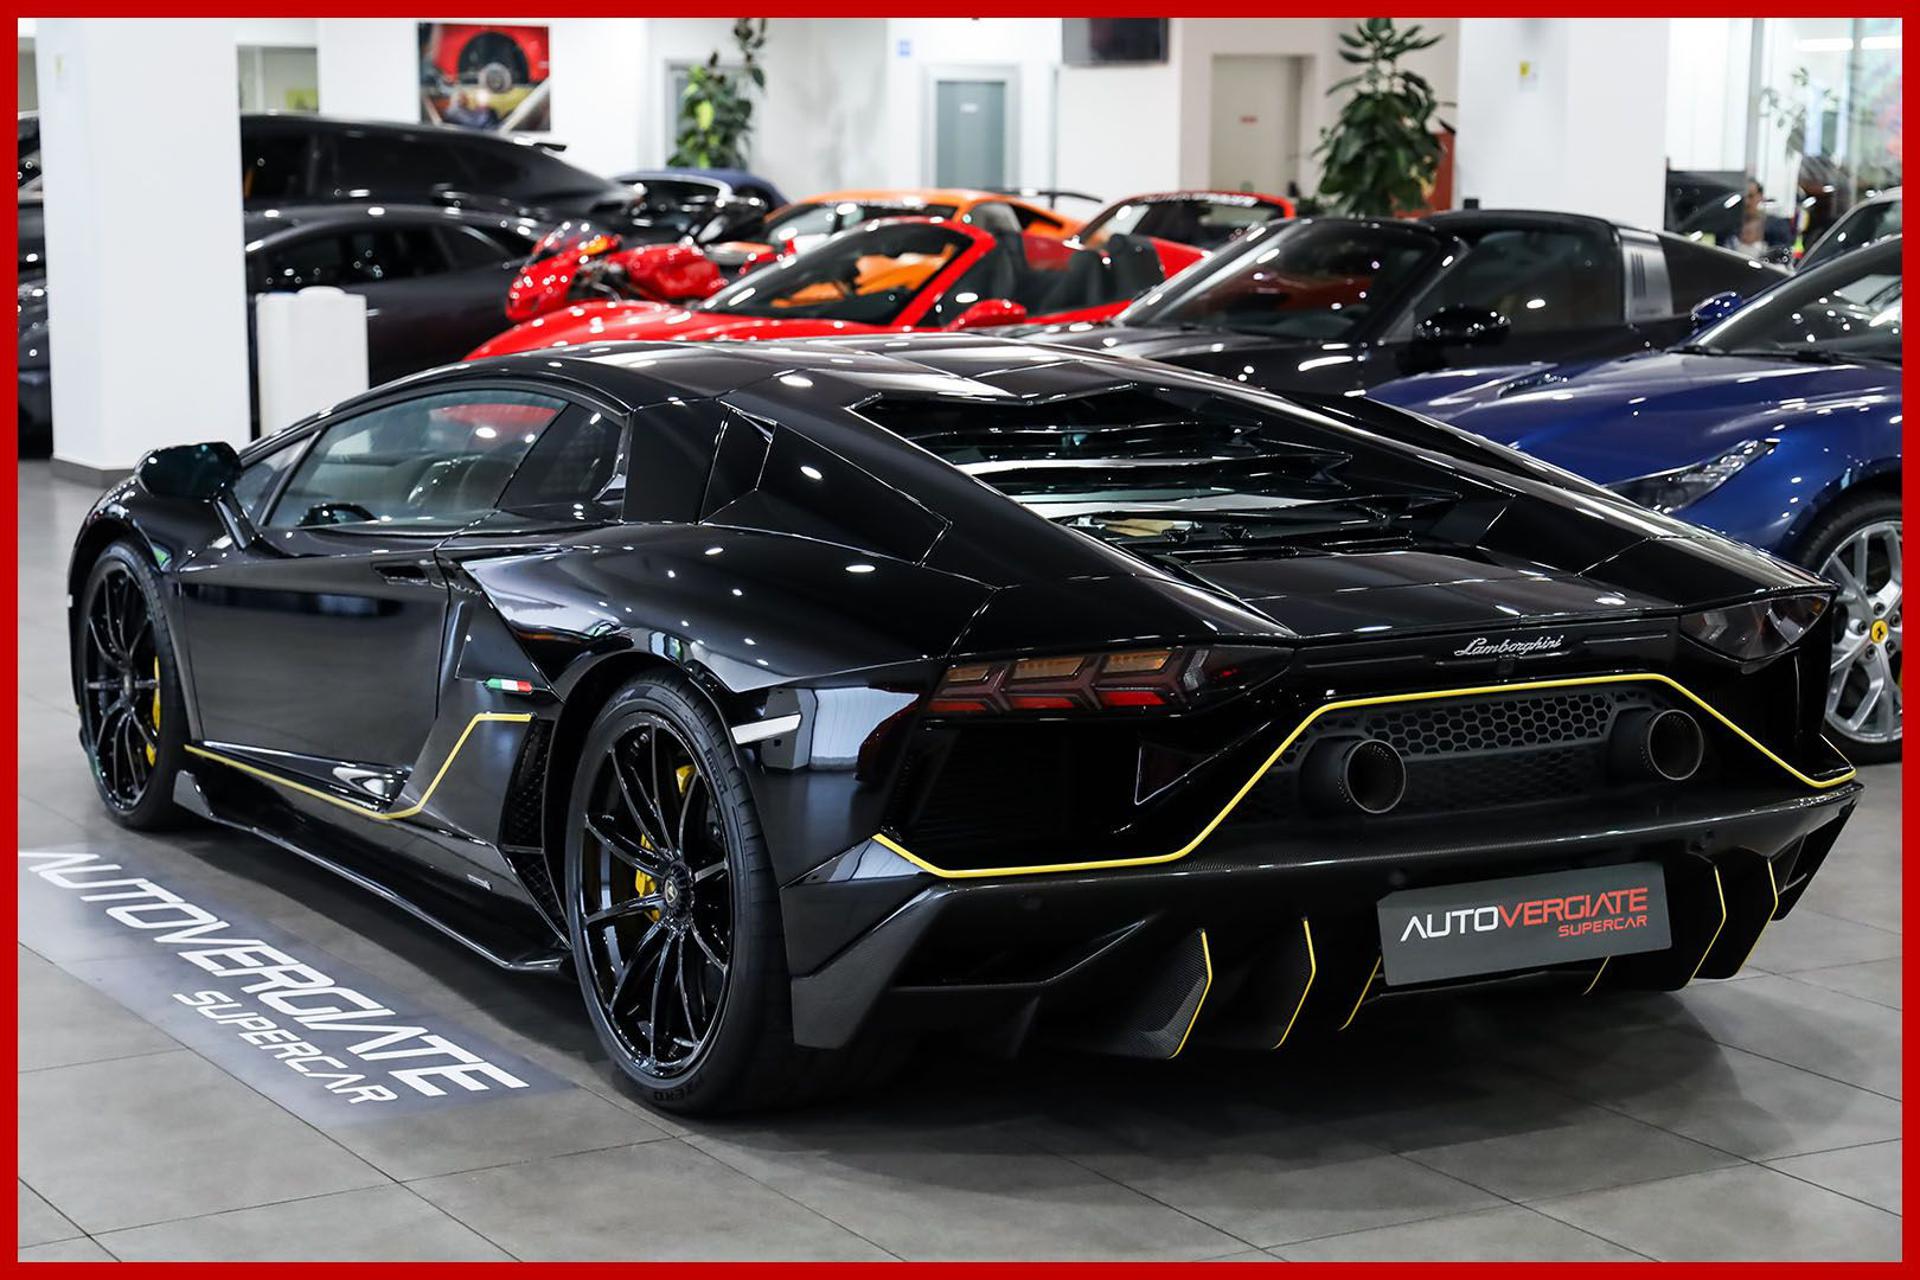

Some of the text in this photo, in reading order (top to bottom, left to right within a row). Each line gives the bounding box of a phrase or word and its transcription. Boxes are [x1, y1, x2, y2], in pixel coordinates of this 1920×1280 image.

[1454, 635, 1564, 657] Lamborghini
[1400, 887, 1648, 942] AUTOVERGIATE
[1558, 914, 1648, 937] SUPERCAR
[18, 850, 530, 1096] AUTOVERGIATE
[172, 990, 398, 1104] SUPERCAR
